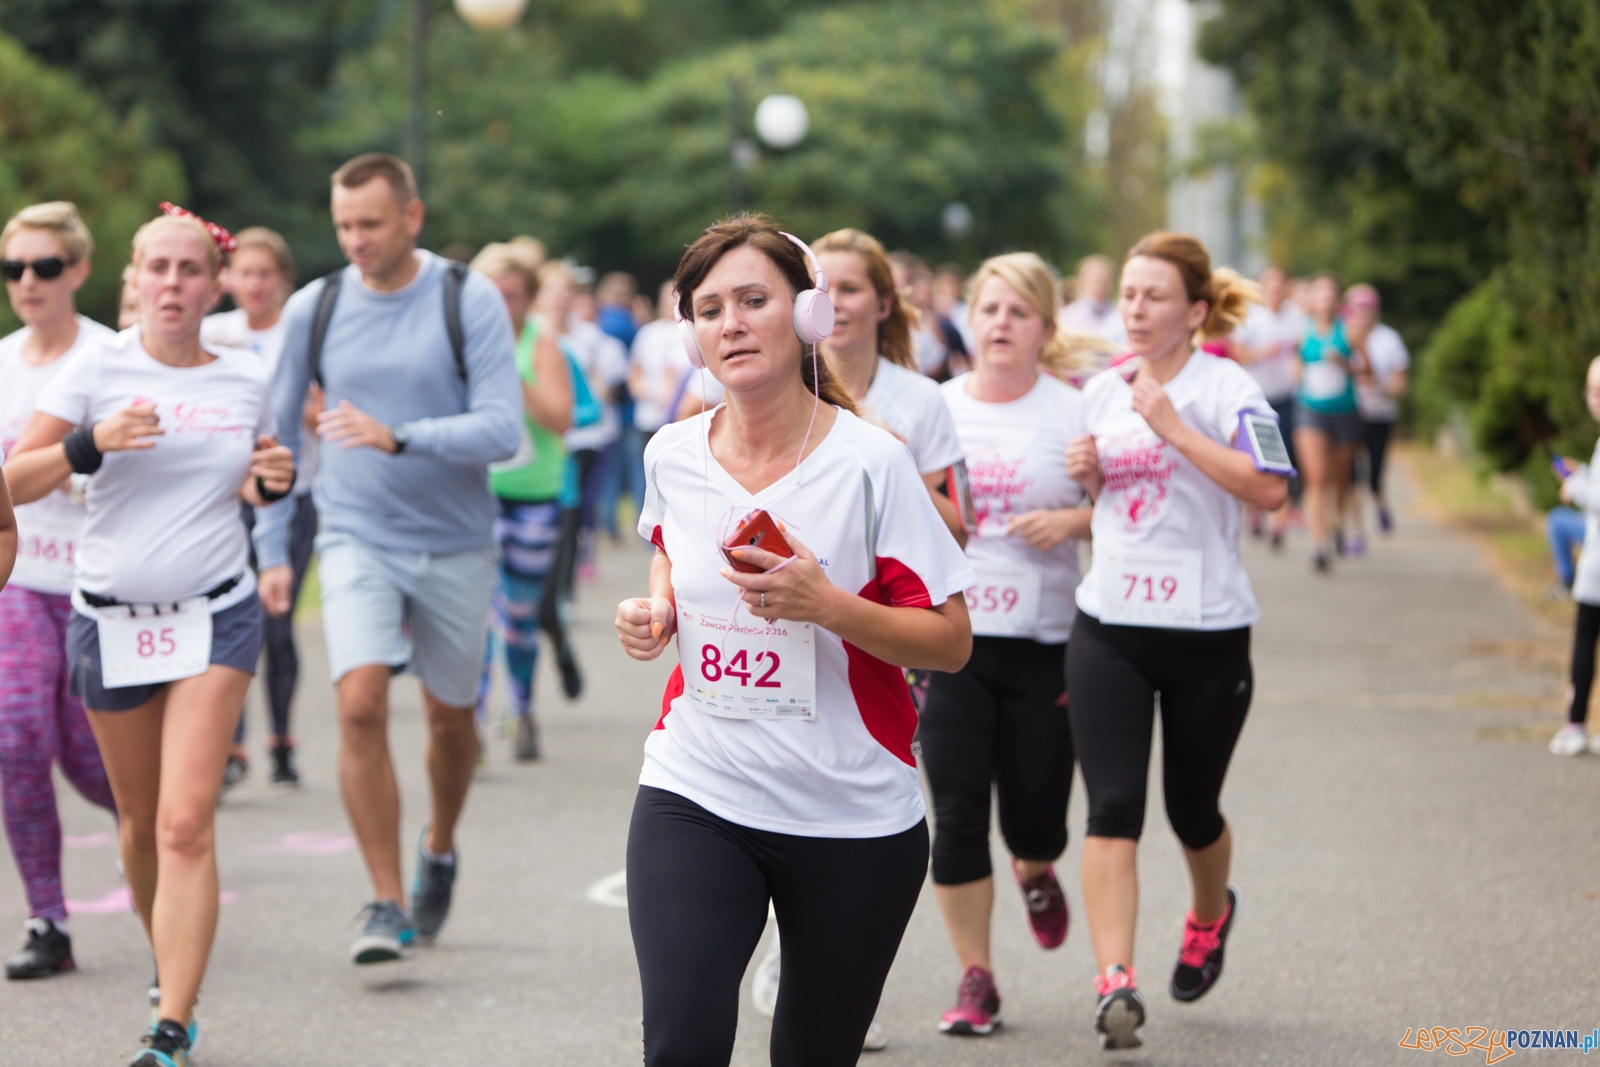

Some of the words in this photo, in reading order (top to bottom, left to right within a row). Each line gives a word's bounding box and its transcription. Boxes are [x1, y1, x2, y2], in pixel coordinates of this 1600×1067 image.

[964, 585, 1019, 613] 559
[1121, 574, 1178, 602] 719
[700, 618, 727, 632] Zawsze
[766, 627, 788, 636] 2016
[136, 628, 177, 658] 85
[701, 643, 782, 688] 842
